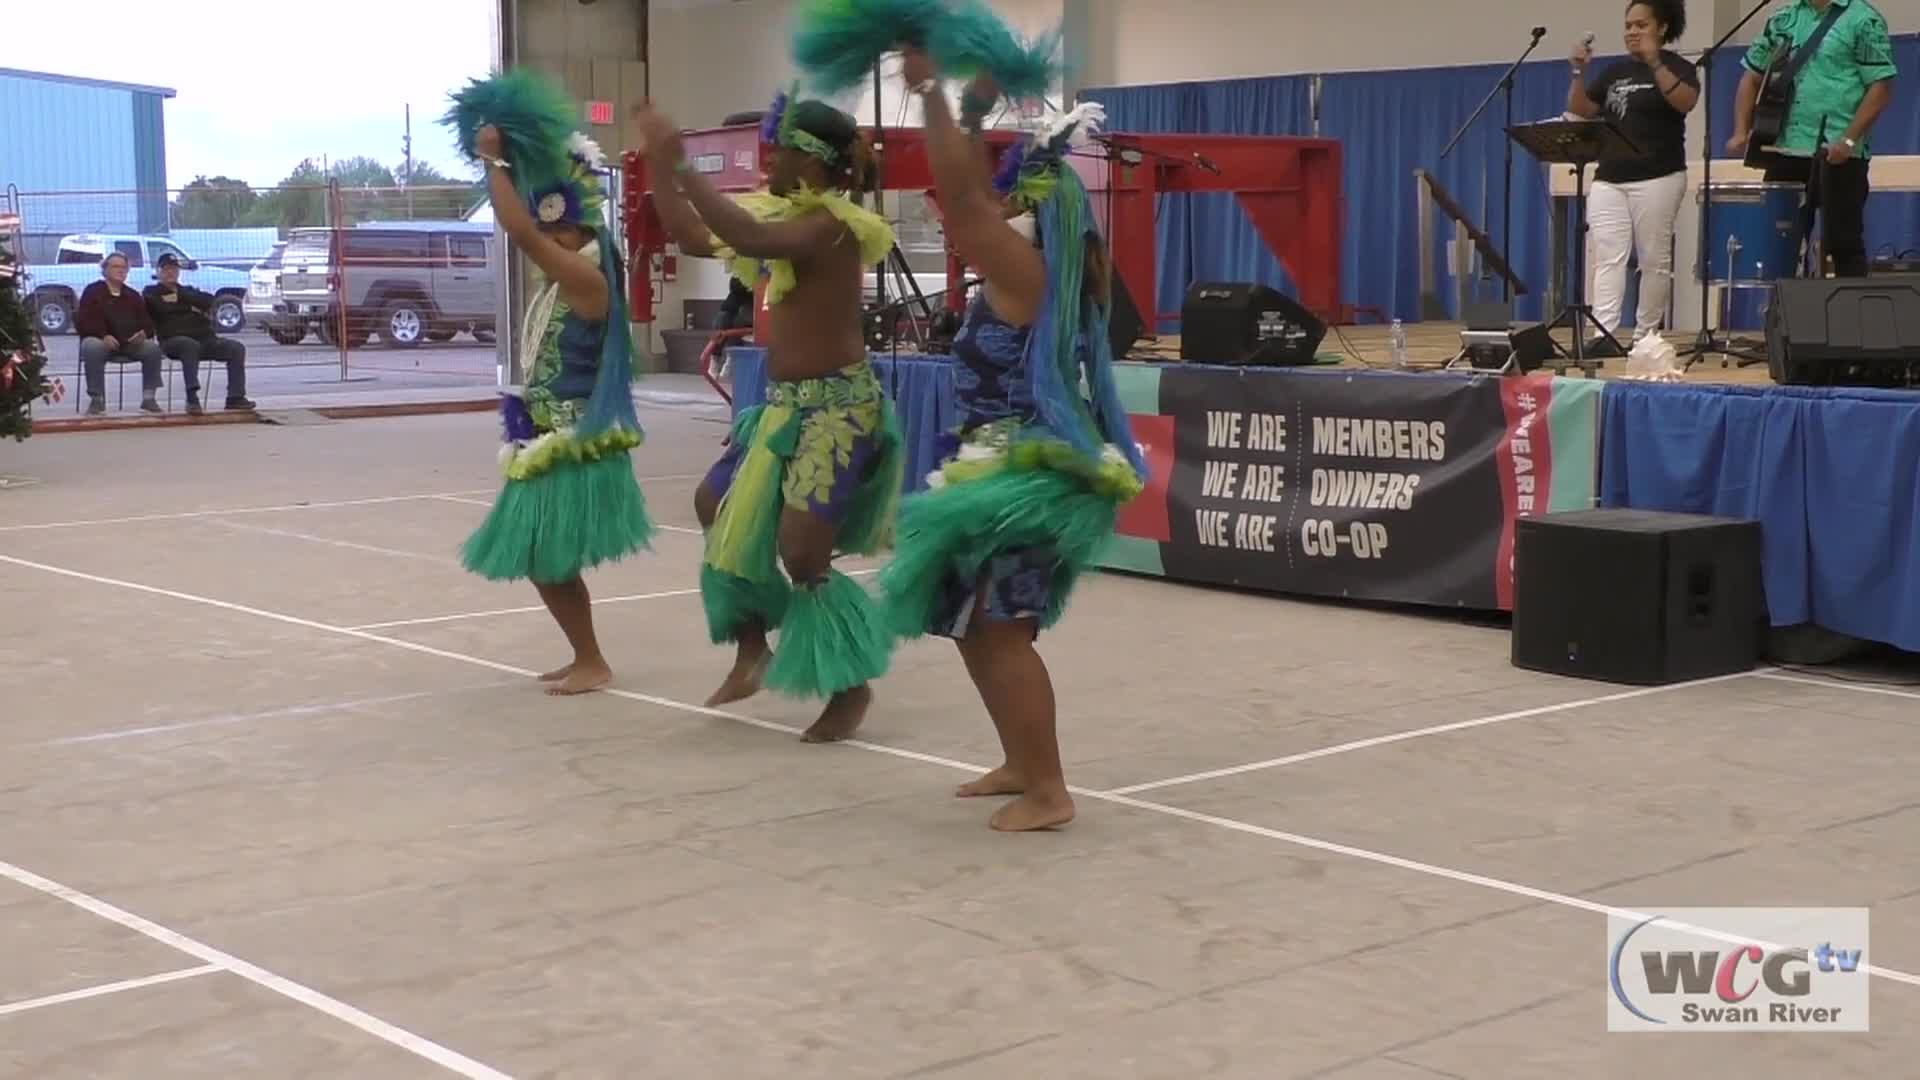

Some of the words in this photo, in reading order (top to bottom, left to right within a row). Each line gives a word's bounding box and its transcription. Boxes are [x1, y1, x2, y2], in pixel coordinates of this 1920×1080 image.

[1207, 411, 1242, 448] WE
[1247, 413, 1287, 452] ARE
[1312, 417, 1446, 460] MEMBERS
[1202, 461, 1239, 498] WE
[1241, 464, 1284, 502] ARE
[1310, 468, 1420, 510] OWNERS
[1195, 509, 1230, 547] WE
[1235, 513, 1277, 552] ARE
[1301, 519, 1388, 559] CO-OP
